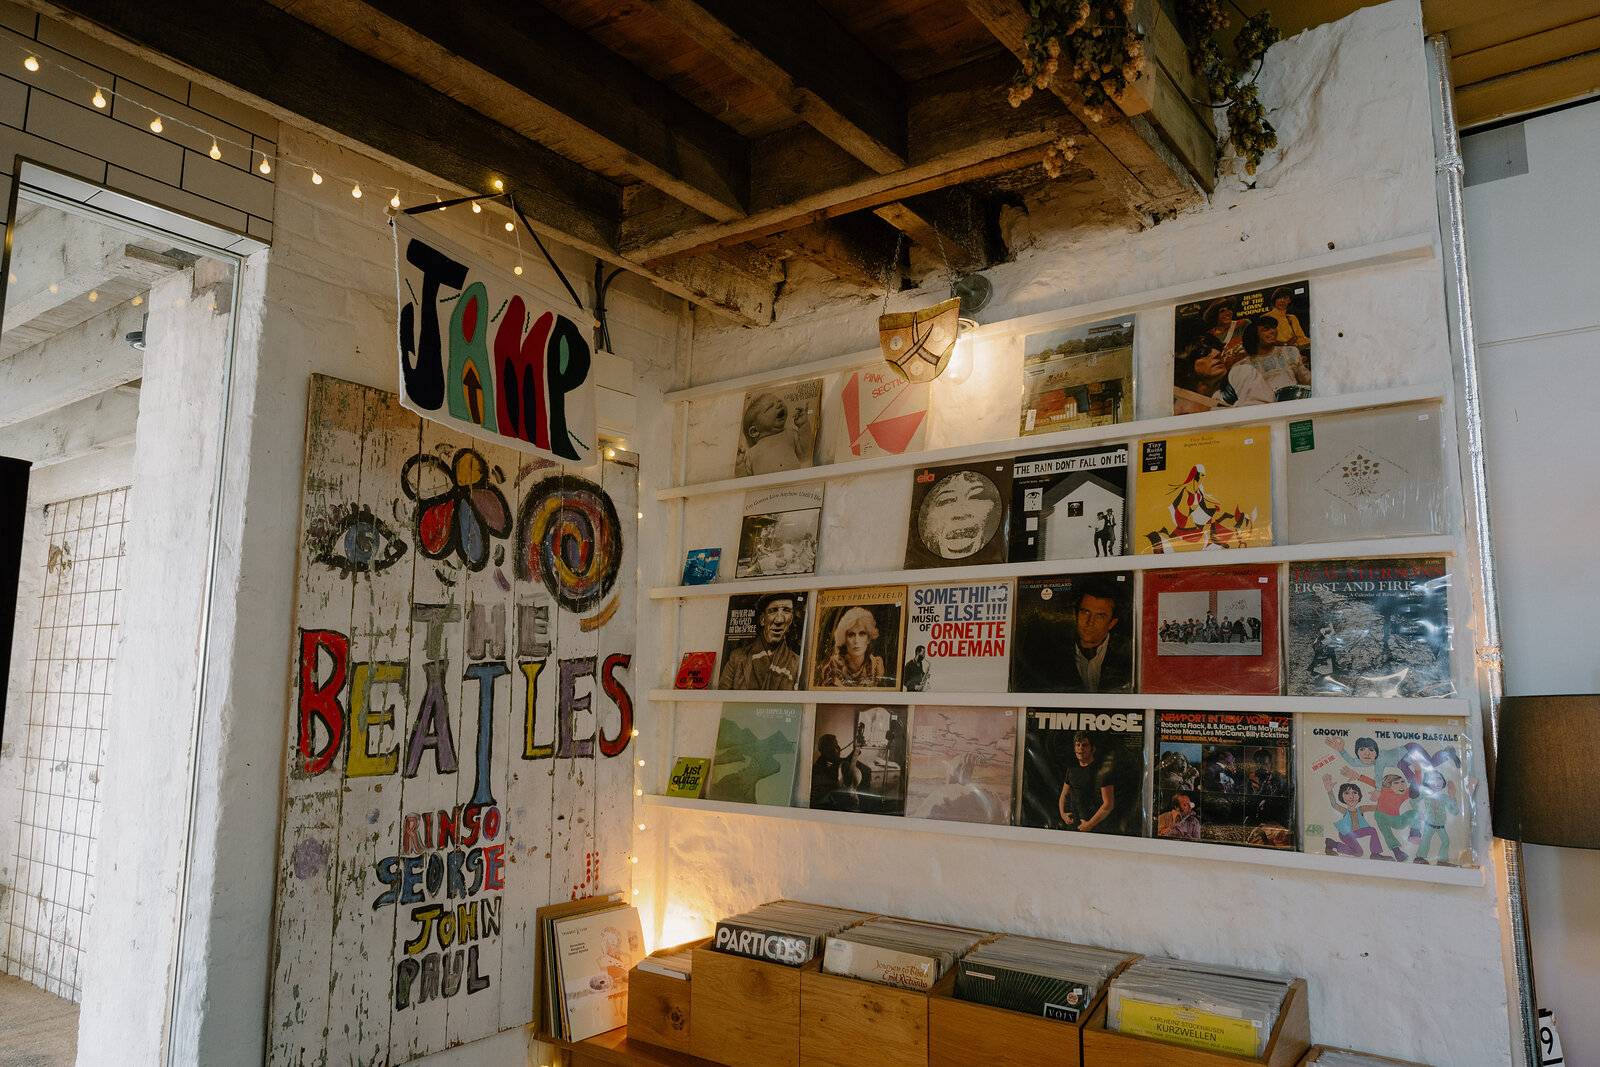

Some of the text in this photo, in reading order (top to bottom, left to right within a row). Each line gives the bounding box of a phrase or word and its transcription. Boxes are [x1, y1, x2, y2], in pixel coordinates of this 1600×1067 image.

[1236, 306, 1270, 317] SPOONFUL
[400, 238, 591, 461] JAMP
[864, 372, 884, 384] PINK
[1015, 466, 1030, 475] THE
[1034, 463, 1052, 472] RAIN
[1080, 458, 1096, 468] FALL
[1101, 456, 1112, 465] ON
[1114, 454, 1126, 464] ME
[917, 470, 935, 483] ella
[1295, 566, 1444, 582] The WATERSONS
[1295, 580, 1412, 593] FROST AND FIRE
[848, 592, 903, 601] SPRINGFIELD
[912, 614, 940, 623] MUSIC
[918, 606, 935, 614] THE
[412, 602, 552, 660] THE
[920, 621, 1006, 640] OF ORNETTE
[927, 640, 1005, 657] COLEMAN
[297, 628, 634, 808] BEATLES
[1034, 712, 1142, 732] TIM ROSE
[1161, 713, 1206, 722] NEWPORT
[1208, 714, 1218, 723] IN
[1221, 715, 1244, 724] NEW
[1246, 716, 1272, 725] YORK
[1393, 732, 1420, 740] YOUNG
[682, 764, 702, 776] just
[404, 896, 502, 955] JOHN
[716, 926, 806, 964] PARTICLES
[396, 945, 490, 1012] PAUL
[1048, 1009, 1074, 1021] VOIX
[1150, 1016, 1181, 1026] KARLHEINZ
[1182, 1021, 1225, 1035] STOCKHAUSEN
[1156, 1024, 1217, 1041] KURZWELLEN
[1540, 1027, 1553, 1055] 9
